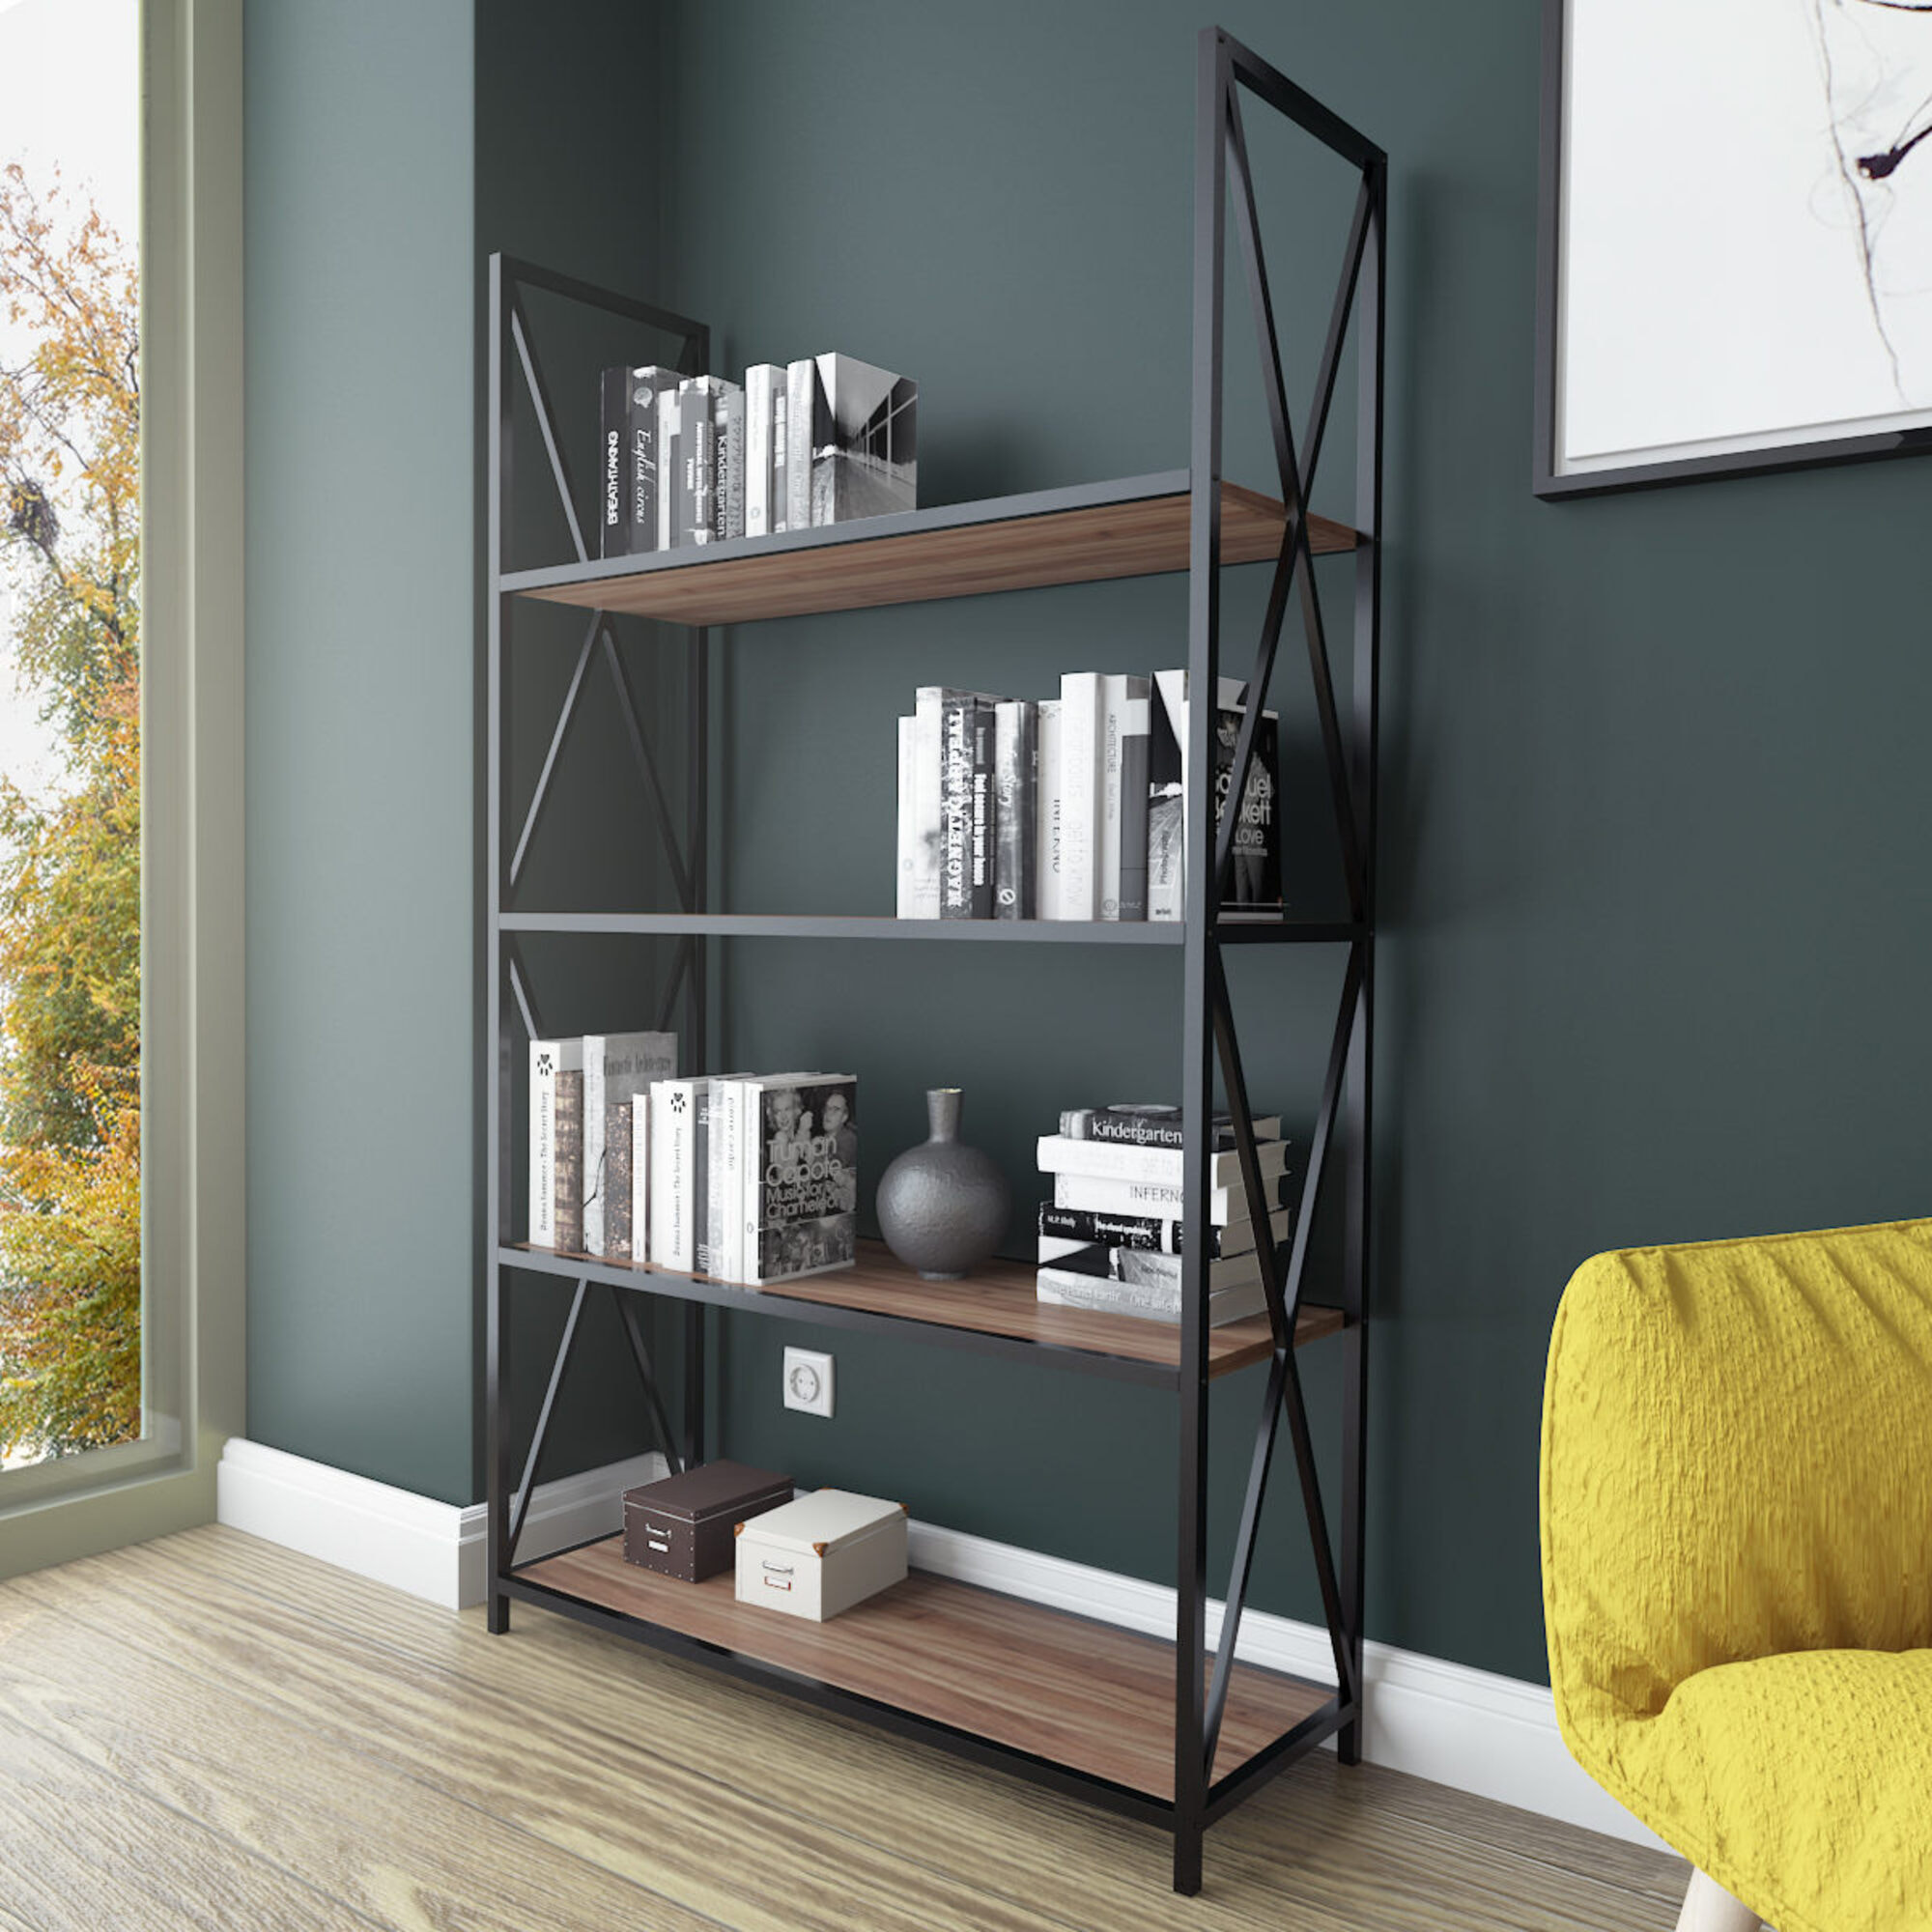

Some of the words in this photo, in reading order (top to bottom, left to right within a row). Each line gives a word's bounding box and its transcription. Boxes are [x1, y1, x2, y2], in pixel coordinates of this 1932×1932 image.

[607, 430, 620, 526] BREATHTAKING
[632, 429, 656, 483] English
[635, 485, 648, 525] circus
[715, 436, 728, 536] Kindergarten
[947, 707, 963, 794] APPEAL
[947, 796, 963, 908] MAGNETIC
[766, 1136, 838, 1163] Truman
[1092, 1117, 1182, 1145] Kindergarten
[766, 1158, 842, 1188] Capote
